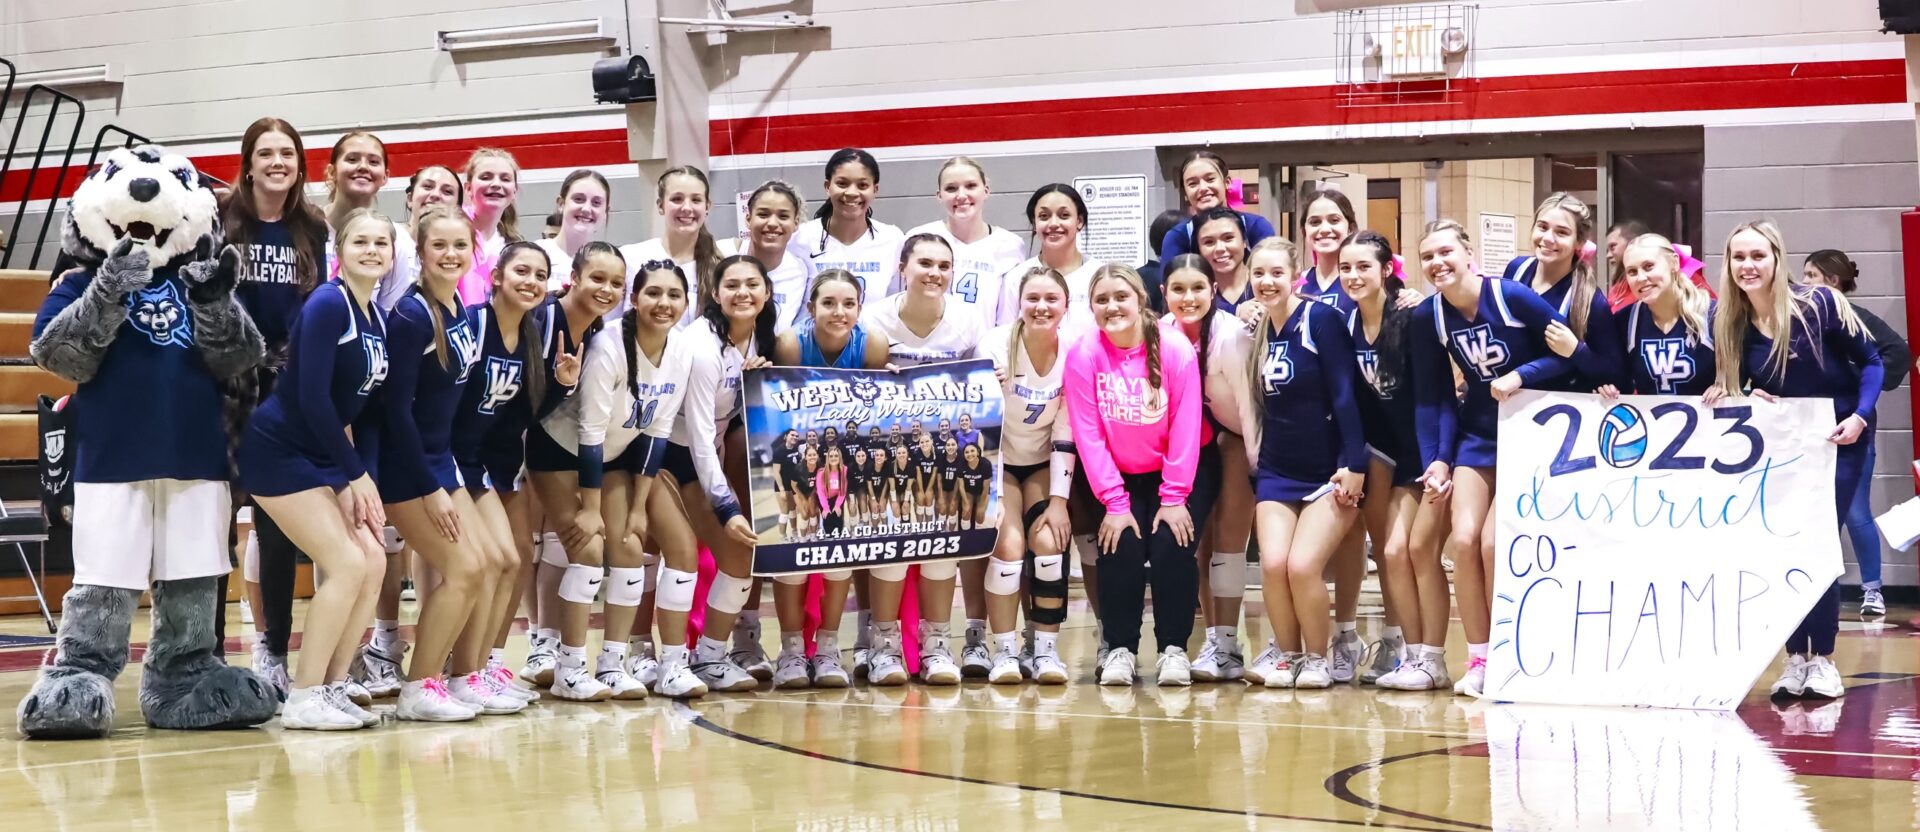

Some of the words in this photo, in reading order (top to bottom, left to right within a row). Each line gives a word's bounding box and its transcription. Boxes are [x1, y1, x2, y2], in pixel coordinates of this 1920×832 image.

[1394, 24, 1433, 58] EXIT
[265, 245, 300, 264] PLAIN
[847, 261, 881, 273] PLAINS
[1641, 337, 1697, 395] WP
[1097, 372, 1139, 395] PLAY
[771, 382, 851, 412] WEST
[879, 380, 984, 403] PLAINS
[1097, 390, 1115, 402] FOR
[1118, 394, 1143, 406] THE
[815, 402, 871, 424] Lady
[1023, 403, 1046, 425] 7
[1098, 402, 1141, 423] CURE
[1516, 453, 1804, 537] district
[815, 527, 850, 540] 4-4A
[854, 520, 945, 538] CO-DISTRICT
[795, 541, 898, 566] CHAMPS
[901, 536, 961, 558] 2023
[1508, 534, 1577, 578] CO-
